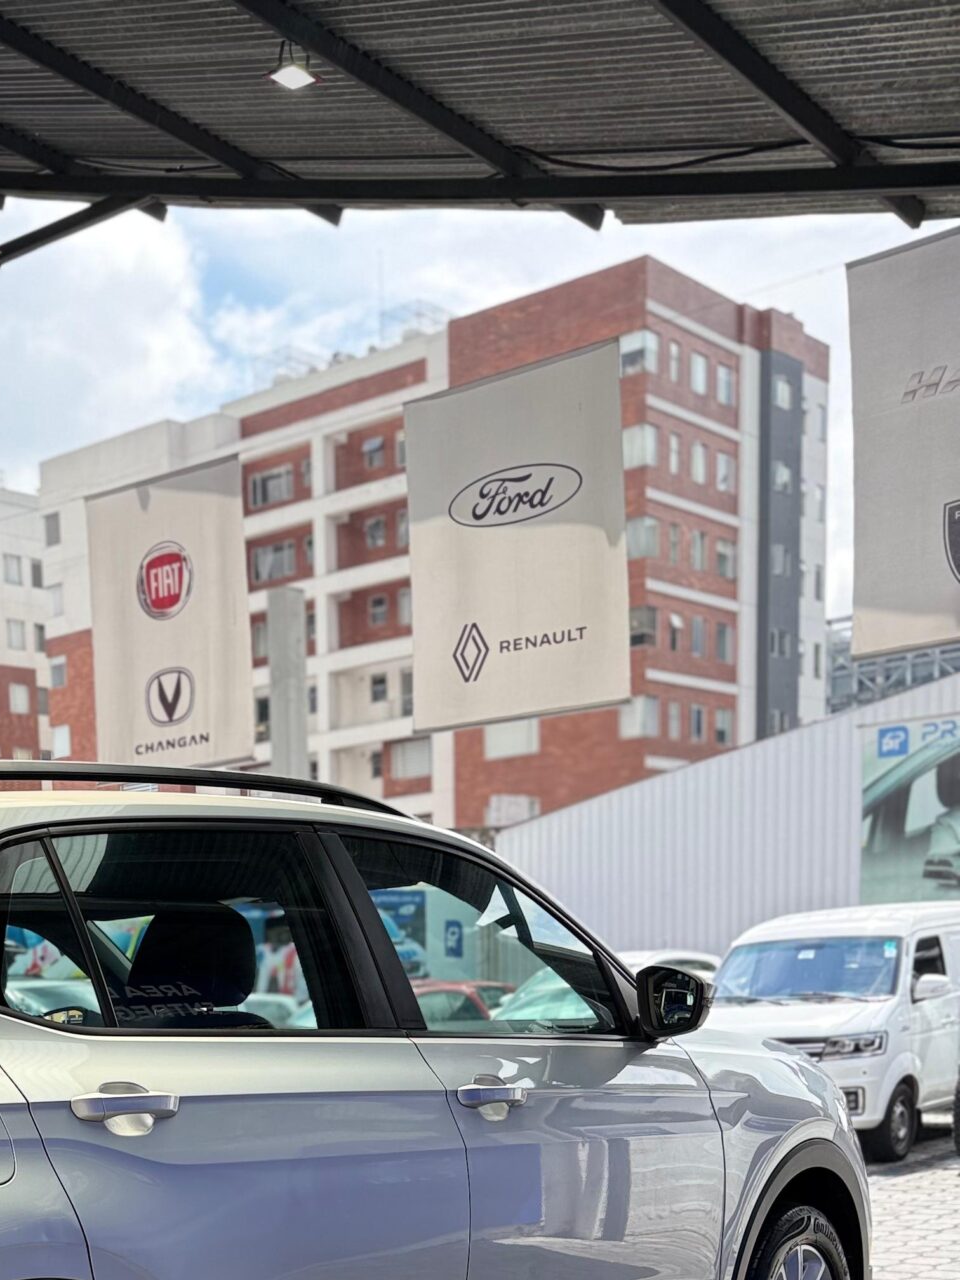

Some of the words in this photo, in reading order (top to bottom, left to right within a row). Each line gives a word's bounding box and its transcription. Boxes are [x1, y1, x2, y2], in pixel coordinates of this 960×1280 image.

[471, 472, 555, 522] Ford
[150, 562, 181, 600] FIAT
[499, 626, 588, 654] RENAULT
[135, 731, 210, 755] CHANGAN
